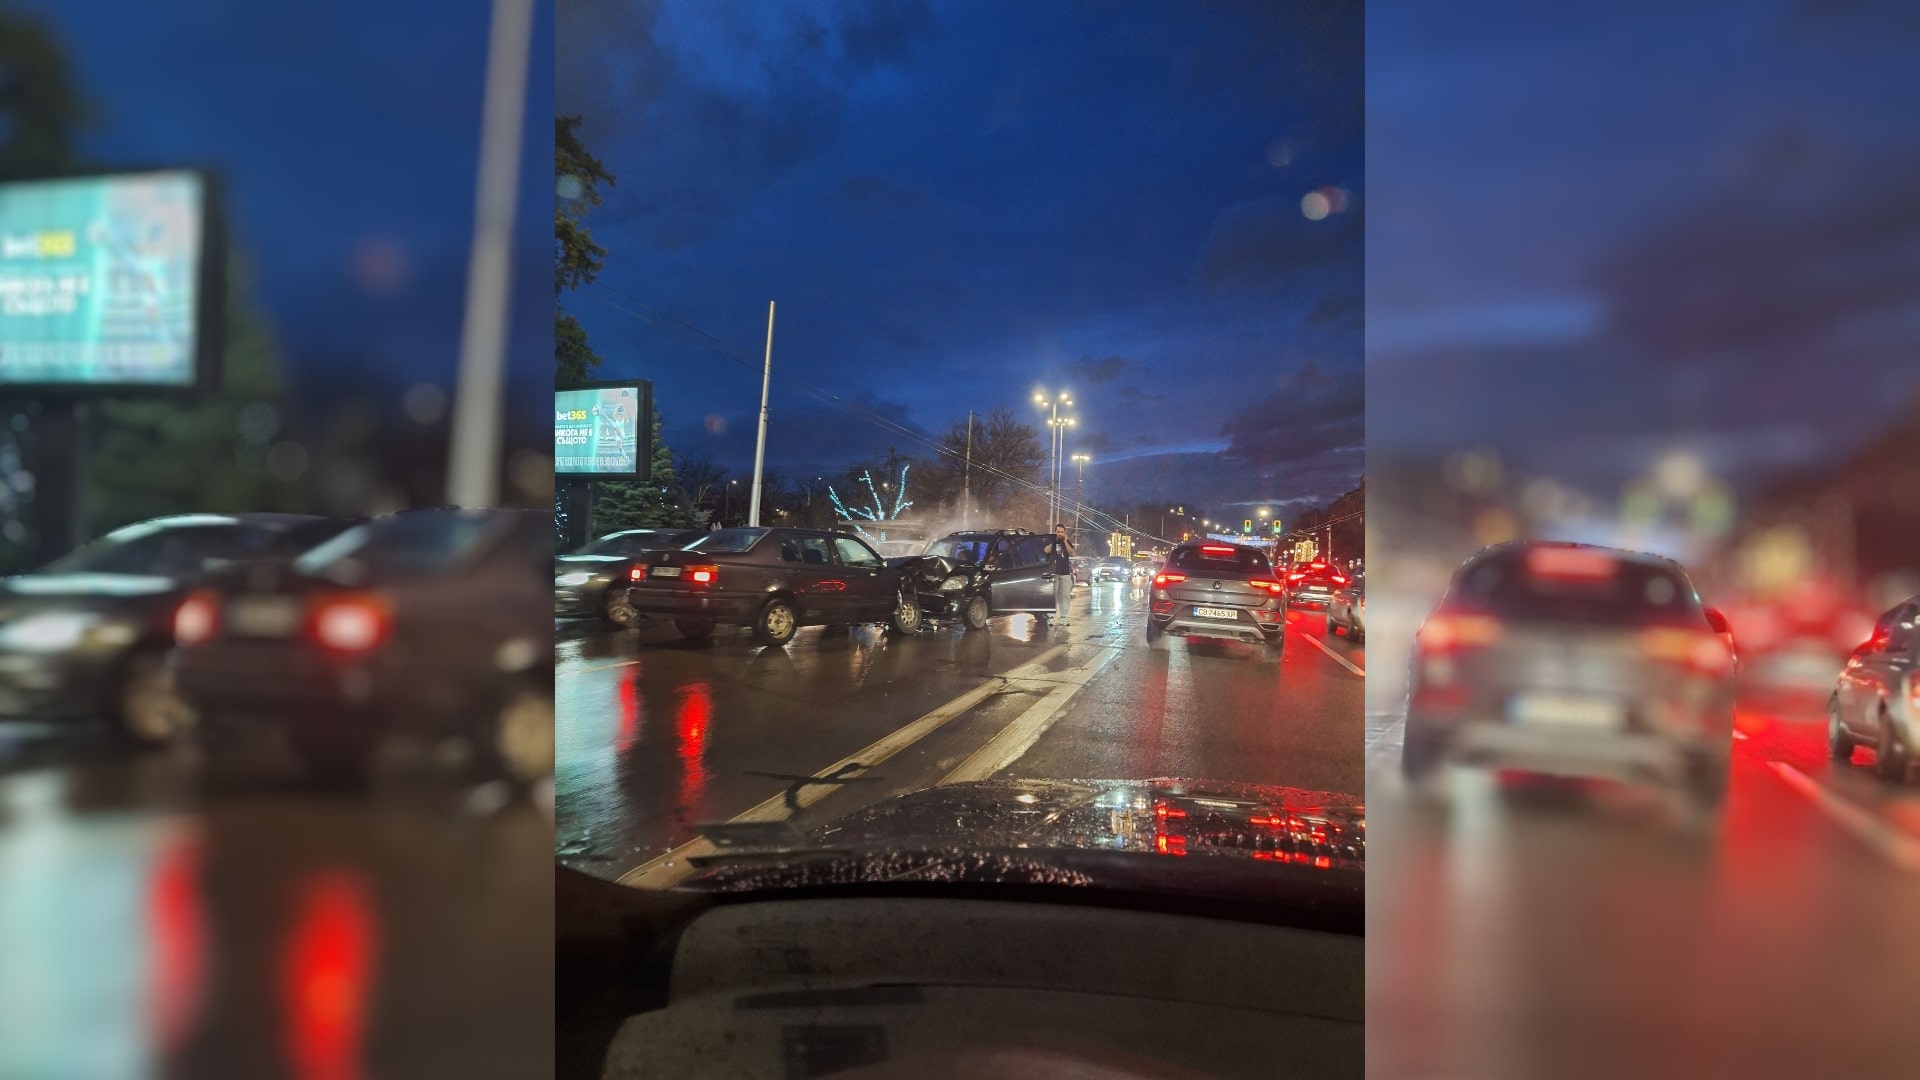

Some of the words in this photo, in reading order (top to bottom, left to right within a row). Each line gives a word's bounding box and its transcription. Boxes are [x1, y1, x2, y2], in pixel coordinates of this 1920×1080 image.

[556, 410, 587, 420] bet365
[555, 428, 578, 437] ИКОГА
[579, 428, 588, 436] НЕ
